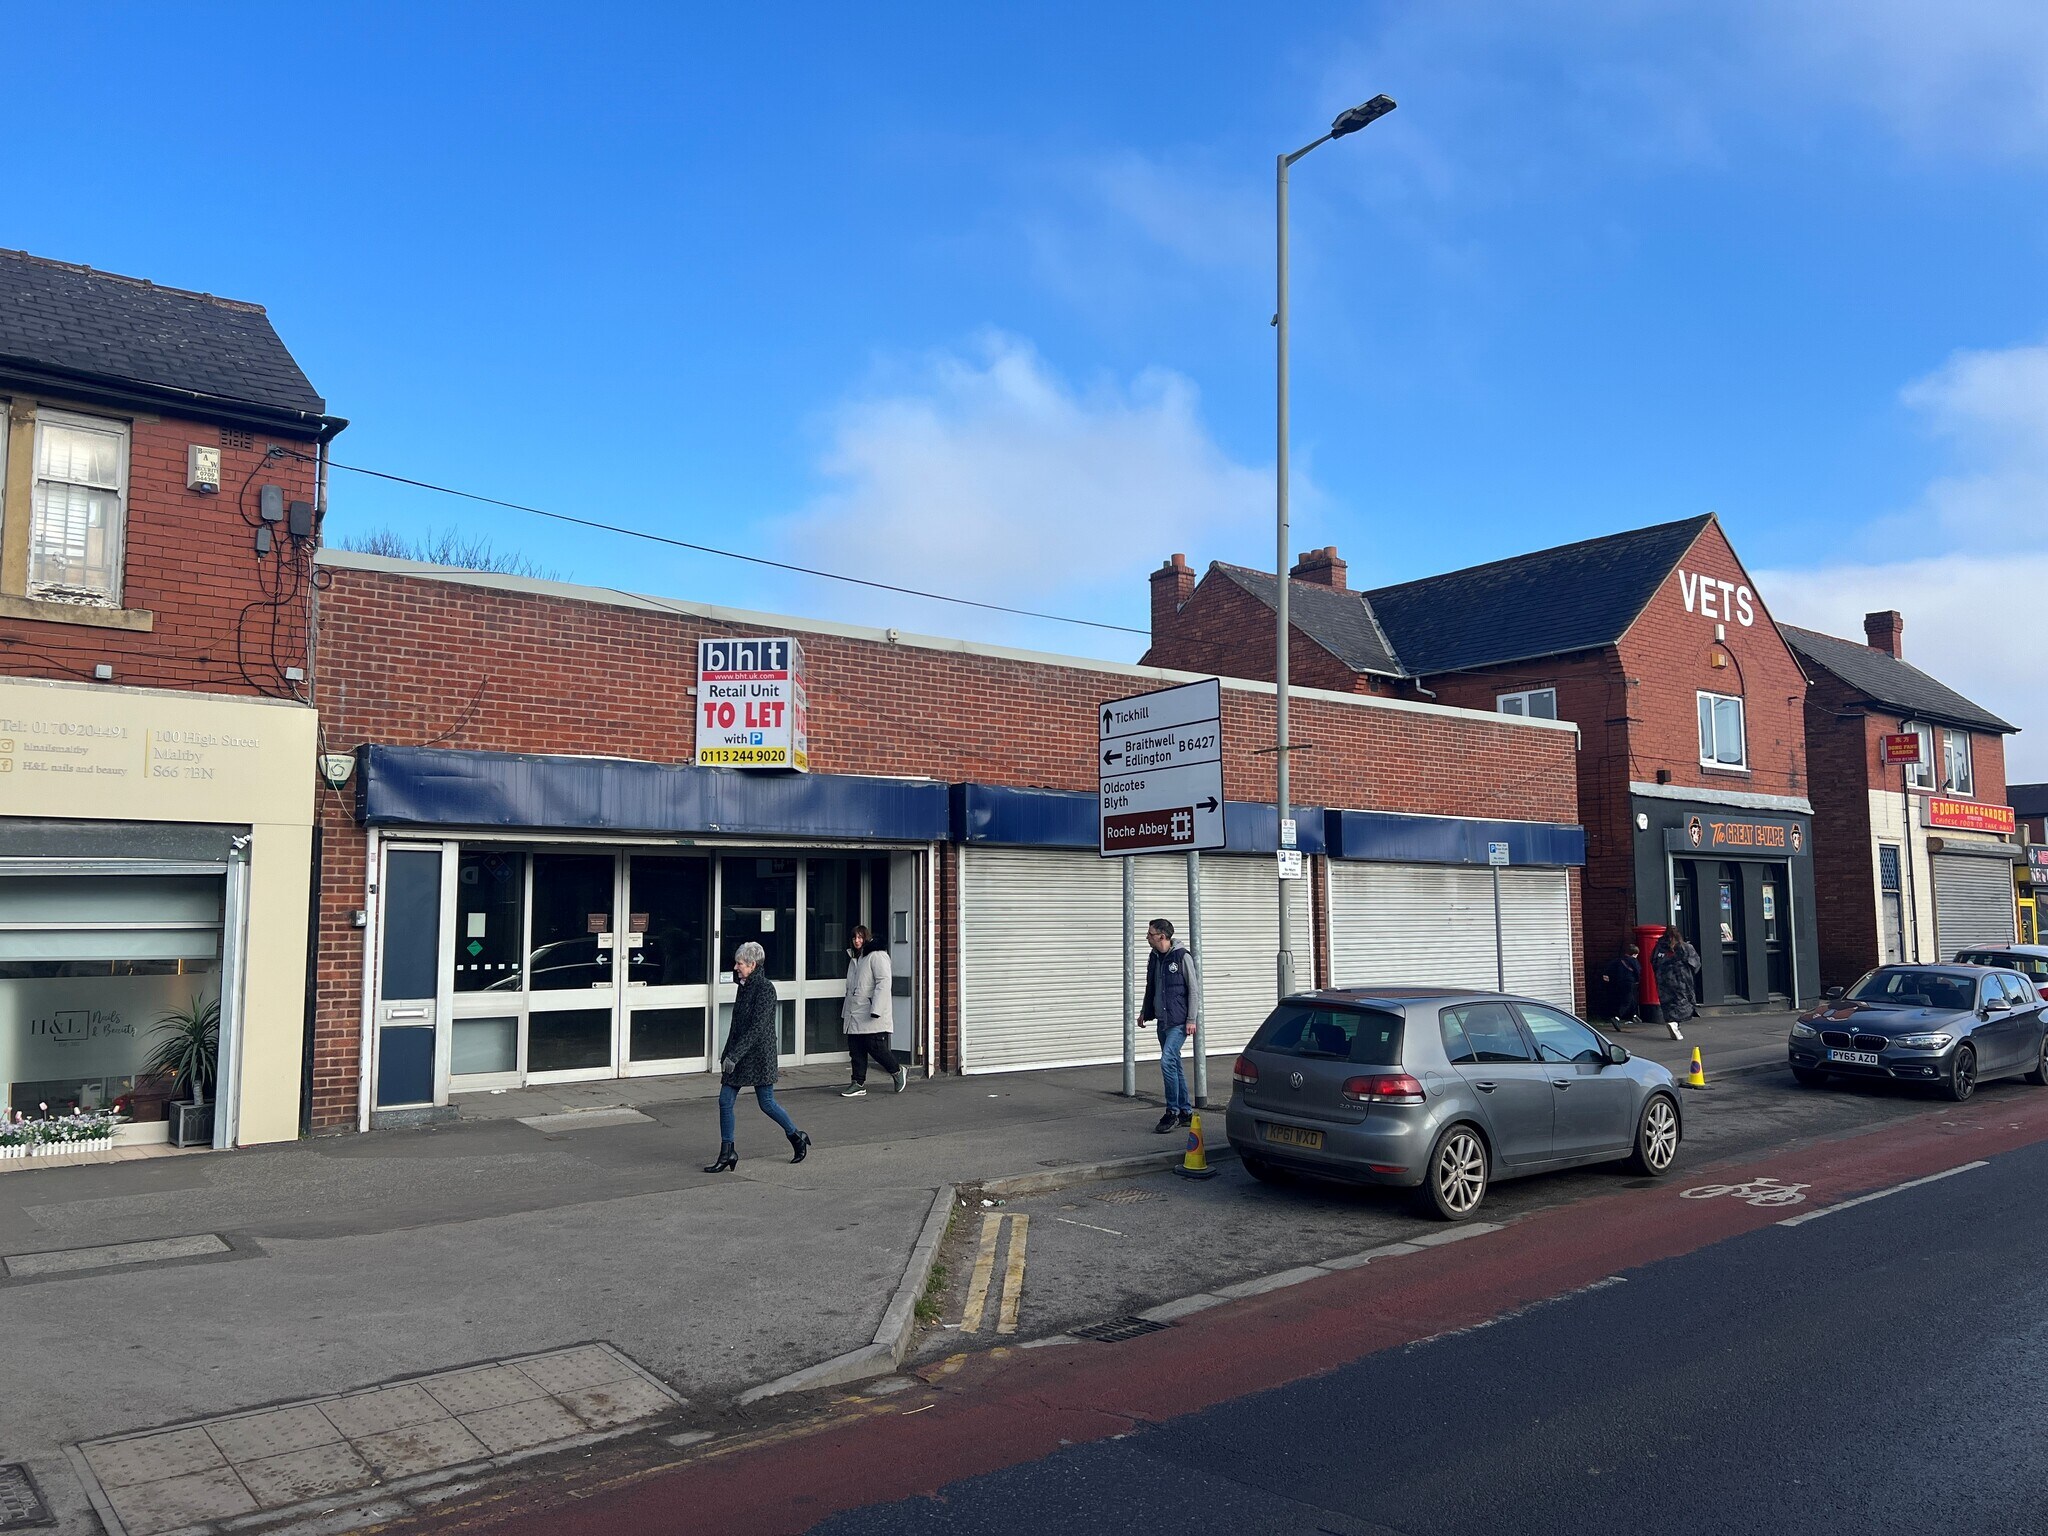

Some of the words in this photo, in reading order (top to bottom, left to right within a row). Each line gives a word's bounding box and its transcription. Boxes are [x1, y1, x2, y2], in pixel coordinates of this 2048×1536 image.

[1678, 570, 1754, 626] VETS
[707, 642, 781, 670] bht
[710, 684, 746, 697] Retail
[751, 684, 779, 696] Unit
[704, 702, 735, 728] TO
[745, 702, 784, 728] LET
[1115, 707, 1149, 724] Tickhill
[0, 719, 27, 732] Tel:
[156, 730, 180, 743] 100
[184, 732, 218, 747] High
[222, 734, 260, 748] Street
[724, 734, 747, 744] with
[1126, 734, 1175, 752] Braithwell
[153, 747, 204, 764] Maltby
[701, 751, 729, 761] 0113
[732, 751, 753, 761] 244
[757, 751, 785, 761] 9020
[1126, 752, 1171, 767] Edlington
[22, 762, 48, 770] H&L
[51, 764, 73, 772] nails
[76, 765, 93, 773] and
[96, 766, 128, 776] beauty
[153, 765, 178, 777] S66
[184, 767, 215, 779] 7BN
[1104, 780, 1145, 794] Oldcotes
[1104, 796, 1128, 809] Blyth
[1940, 802, 1959, 815] DONG
[1961, 805, 1978, 815] FANG
[1980, 807, 2007, 823] GARDEN
[1936, 818, 1958, 826] CHINESE
[1108, 826, 1135, 838] Roche
[1138, 823, 1168, 836] Abbey
[1710, 822, 1725, 847] The
[1726, 823, 1753, 845] GREAT
[1755, 825, 1785, 847] E-VAPE
[93, 1011, 120, 1024] Nails
[1833, 1051, 1856, 1061] PY65
[1858, 1054, 1876, 1063] AZO
[1270, 1125, 1293, 1141] KP61
[1295, 1129, 1318, 1145] WXD
